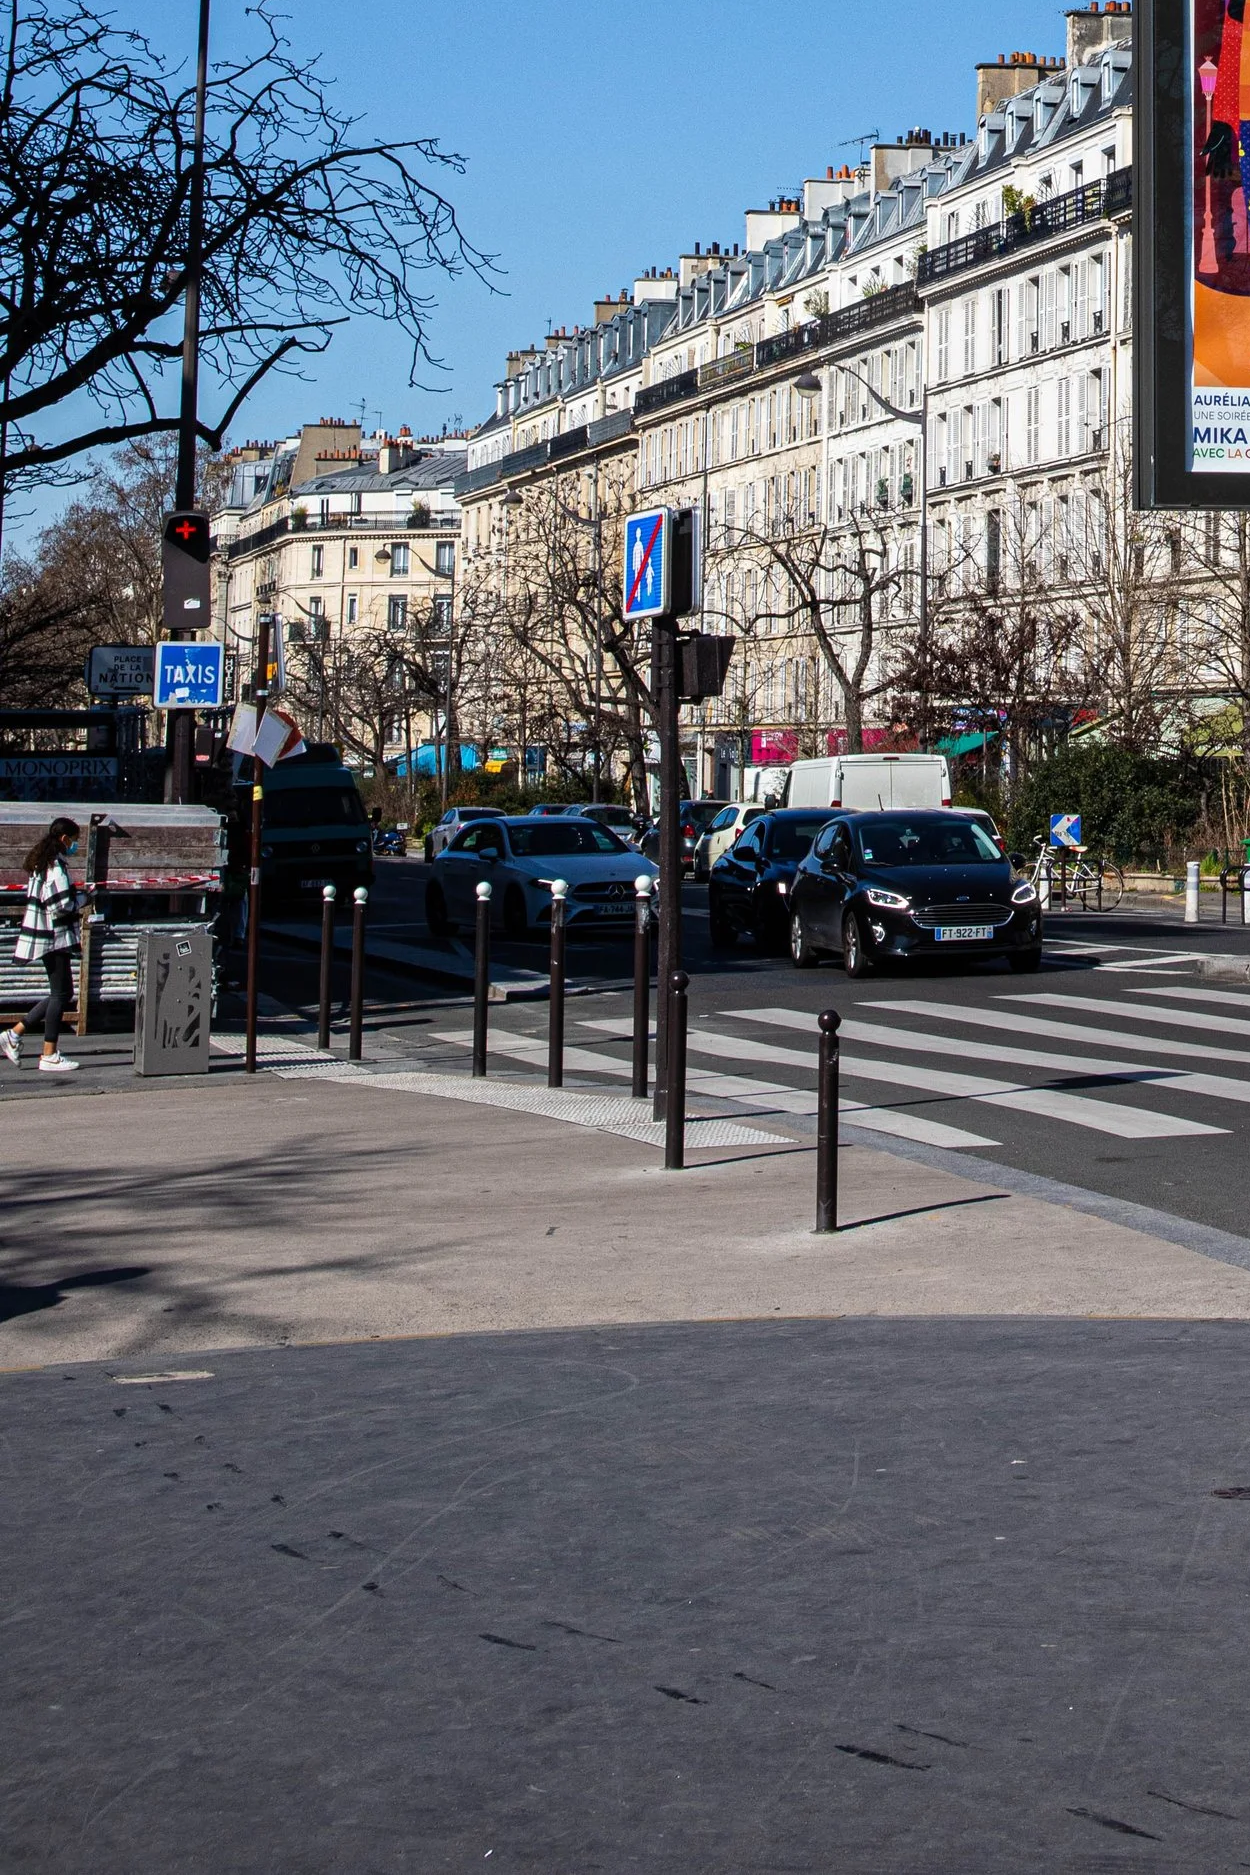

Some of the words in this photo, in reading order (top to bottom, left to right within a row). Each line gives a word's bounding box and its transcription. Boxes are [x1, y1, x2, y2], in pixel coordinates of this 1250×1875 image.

[1194, 392, 1250, 407] AURÉLIA
[1194, 411, 1215, 420] UNE
[1193, 427, 1248, 444] MIKA
[1192, 448, 1225, 458] AVEC
[1228, 449, 1243, 459] LA
[114, 655, 142, 663] PLACE
[99, 673, 154, 683] NATION
[165, 665, 215, 684] TAXIS
[4, 760, 112, 776] MONOPRIX
[942, 927, 987, 938] FT-922-FT
